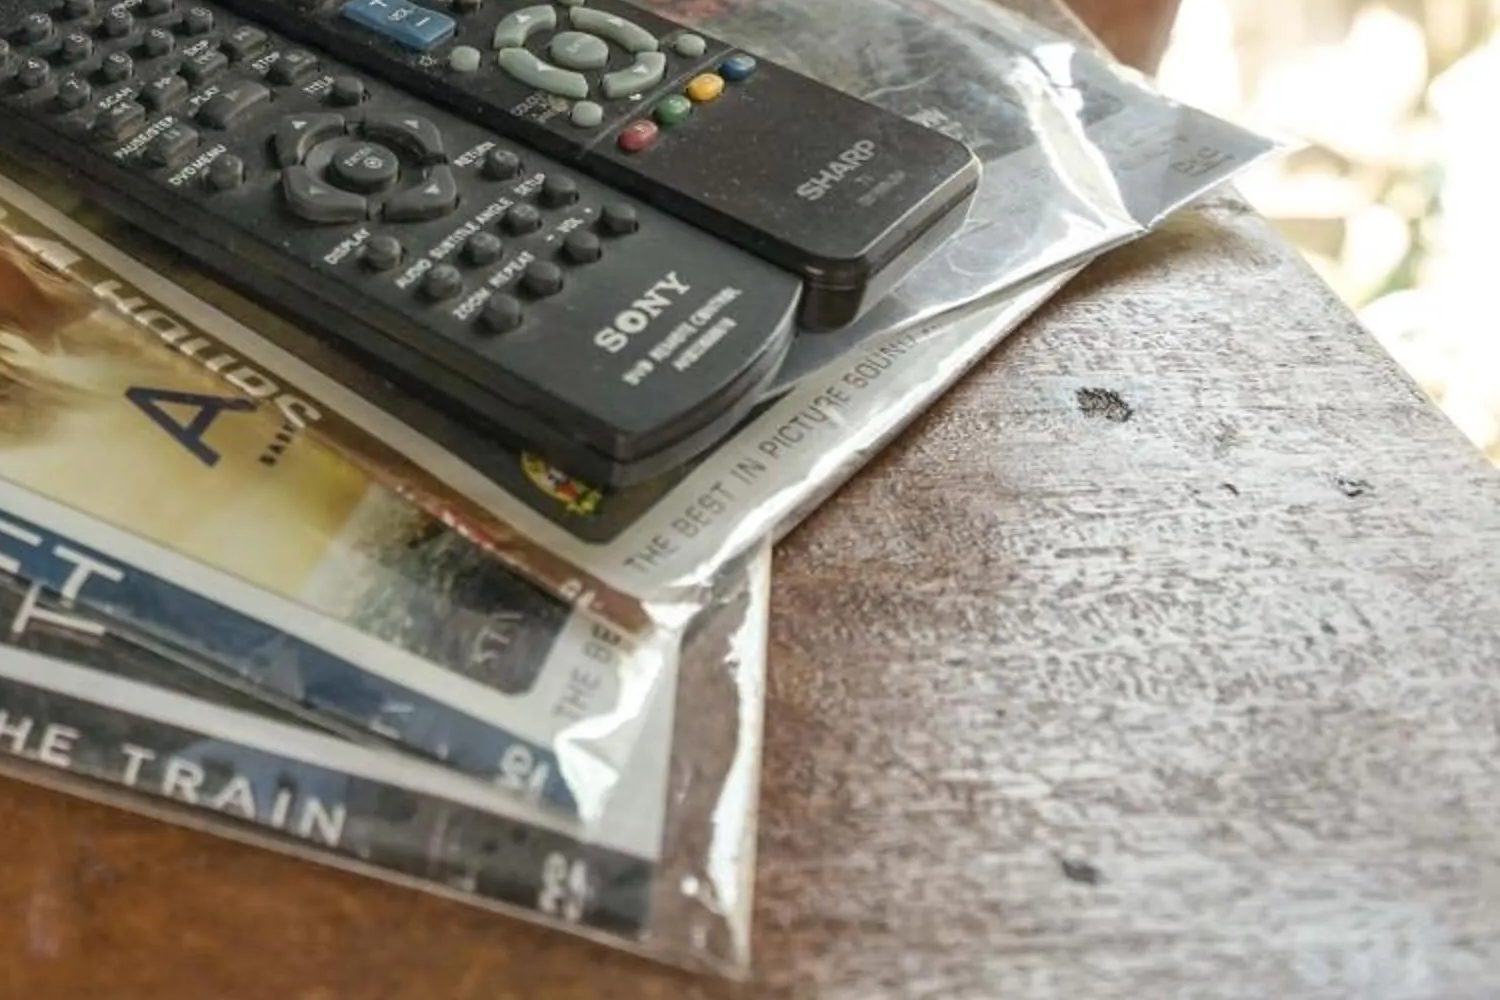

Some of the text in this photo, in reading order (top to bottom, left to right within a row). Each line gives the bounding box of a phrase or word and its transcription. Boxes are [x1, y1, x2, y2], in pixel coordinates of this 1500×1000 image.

[796, 139, 876, 201] SHARP
[594, 271, 691, 354] SONY
[623, 535, 677, 573] THE
[672, 481, 733, 539] BEST
[730, 457, 767, 485] IN
[120, 743, 348, 847] TRAIN
